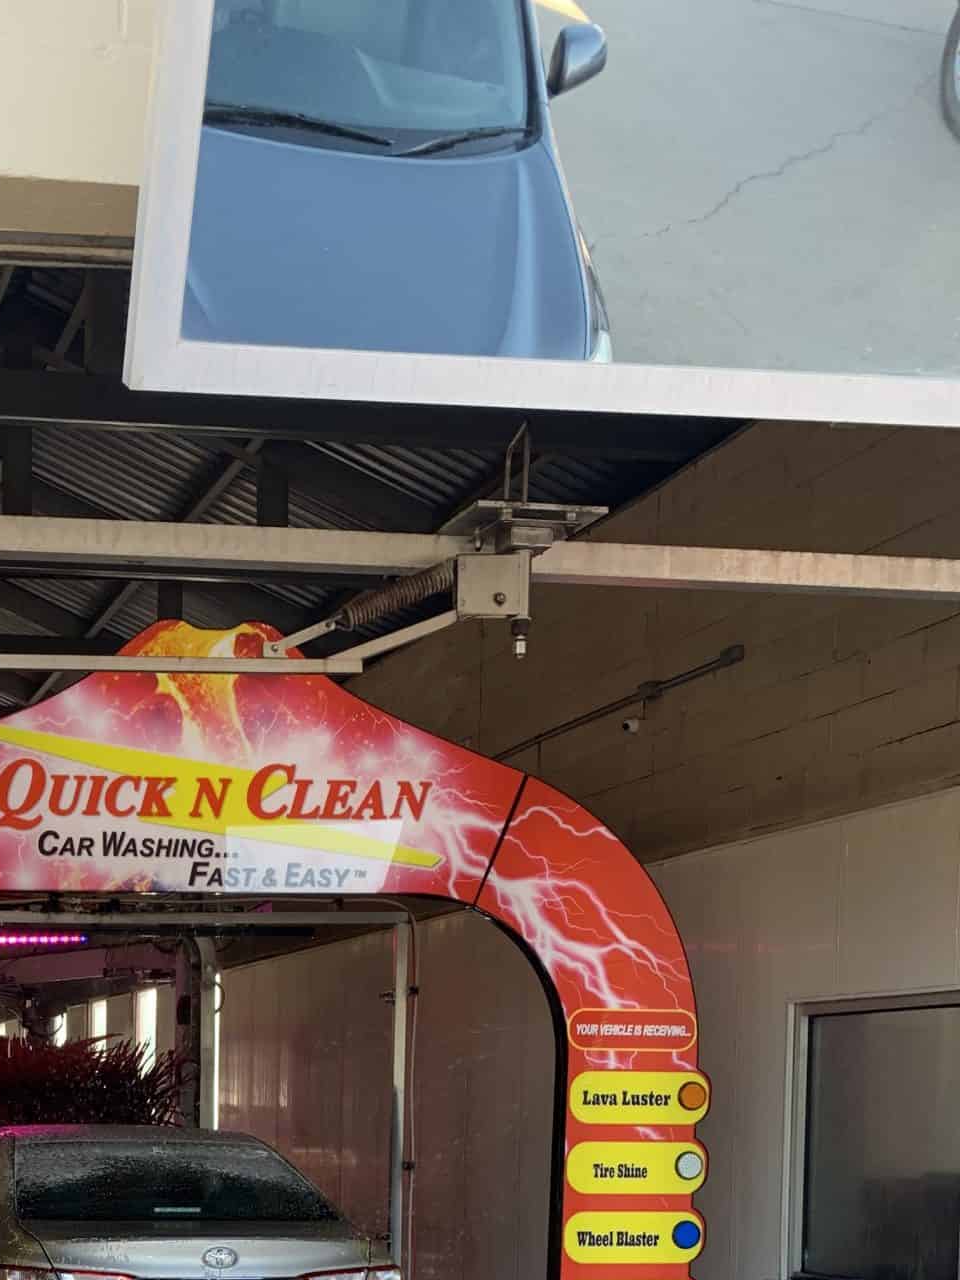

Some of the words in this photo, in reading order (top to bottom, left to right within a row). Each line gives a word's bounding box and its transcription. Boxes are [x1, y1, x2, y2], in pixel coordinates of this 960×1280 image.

[190, 777, 232, 819] N
[246, 763, 433, 822] CLEAN
[38, 830, 95, 857] CAR
[188, 862, 257, 887] FAST
[261, 868, 277, 887] &
[576, 1024, 598, 1036] YOUR
[600, 1024, 633, 1036] VEHICLE
[634, 1024, 642, 1036] IS
[582, 1090, 617, 1106] Lava
[622, 1090, 671, 1106] Luster
[593, 1163, 615, 1178] Tire
[617, 1163, 647, 1178] Shine
[577, 1231, 613, 1247] Wheel
[616, 1231, 659, 1247] Blaster
